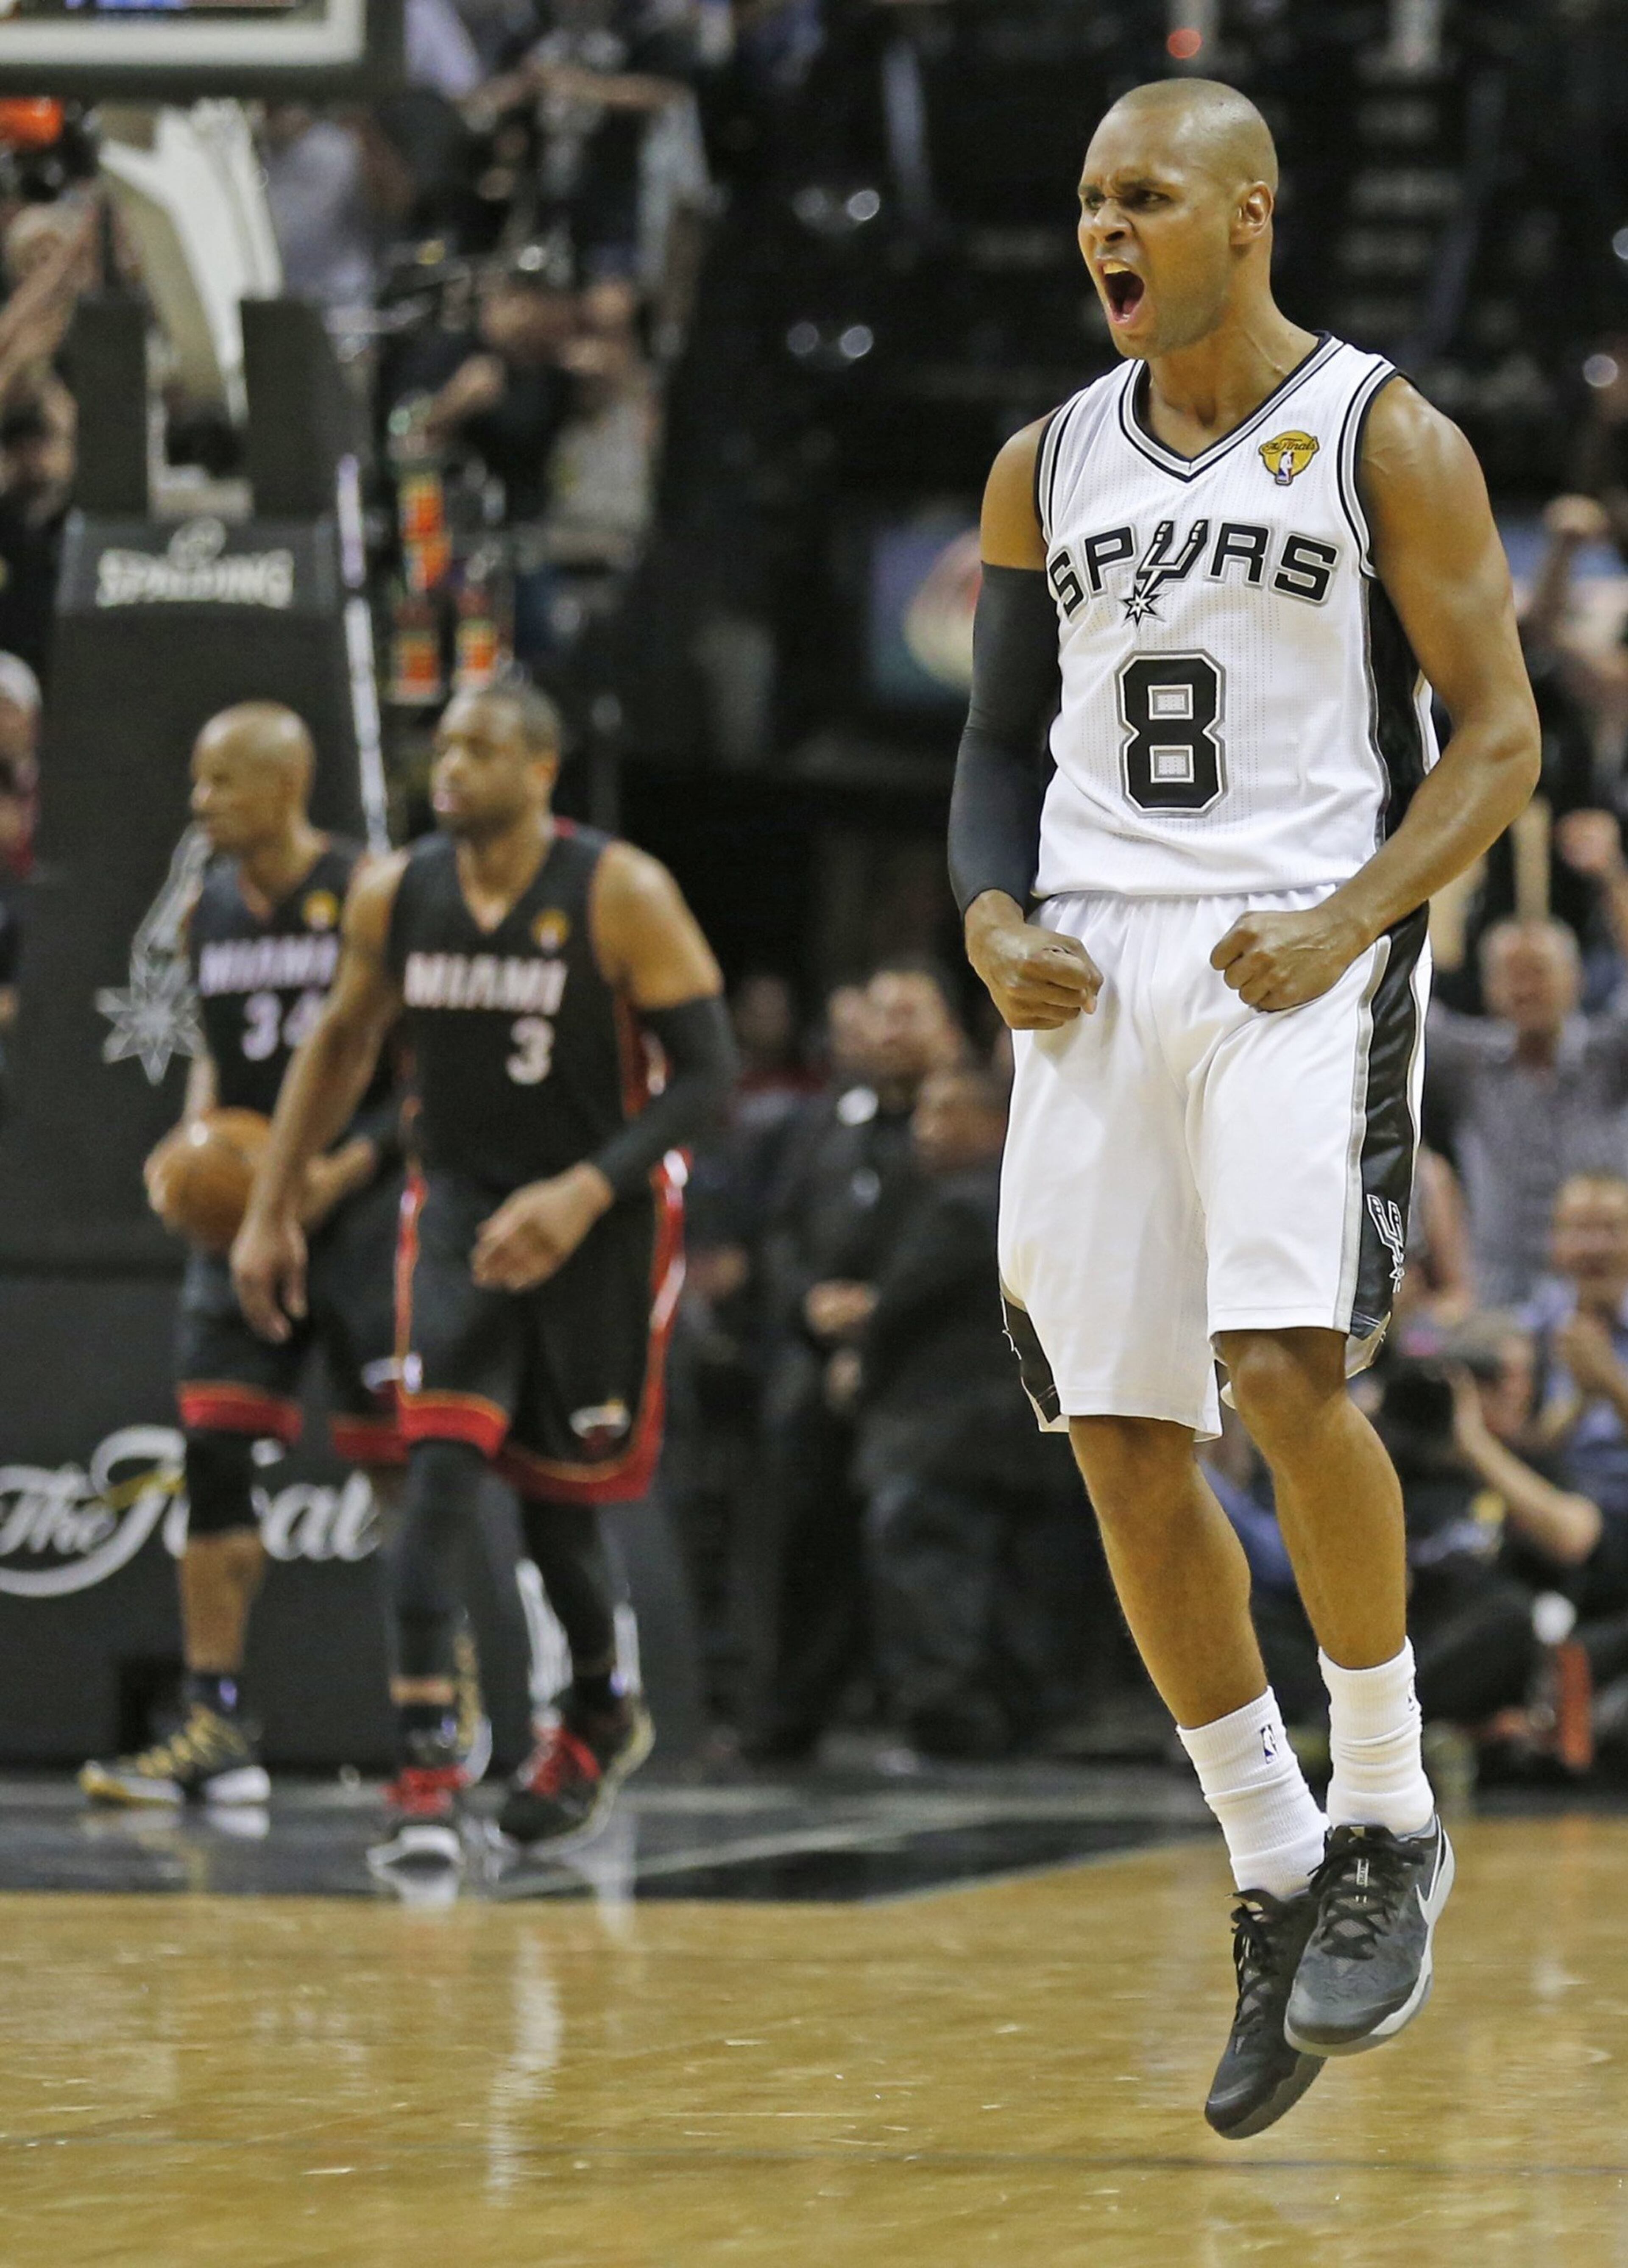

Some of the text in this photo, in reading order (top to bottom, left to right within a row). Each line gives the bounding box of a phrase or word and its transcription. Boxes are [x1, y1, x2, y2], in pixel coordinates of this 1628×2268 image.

[1047, 519, 1339, 626] SPURS
[1115, 648, 1227, 817] 8
[404, 952, 568, 1016] MIAMI
[506, 1017, 555, 1084] 3
